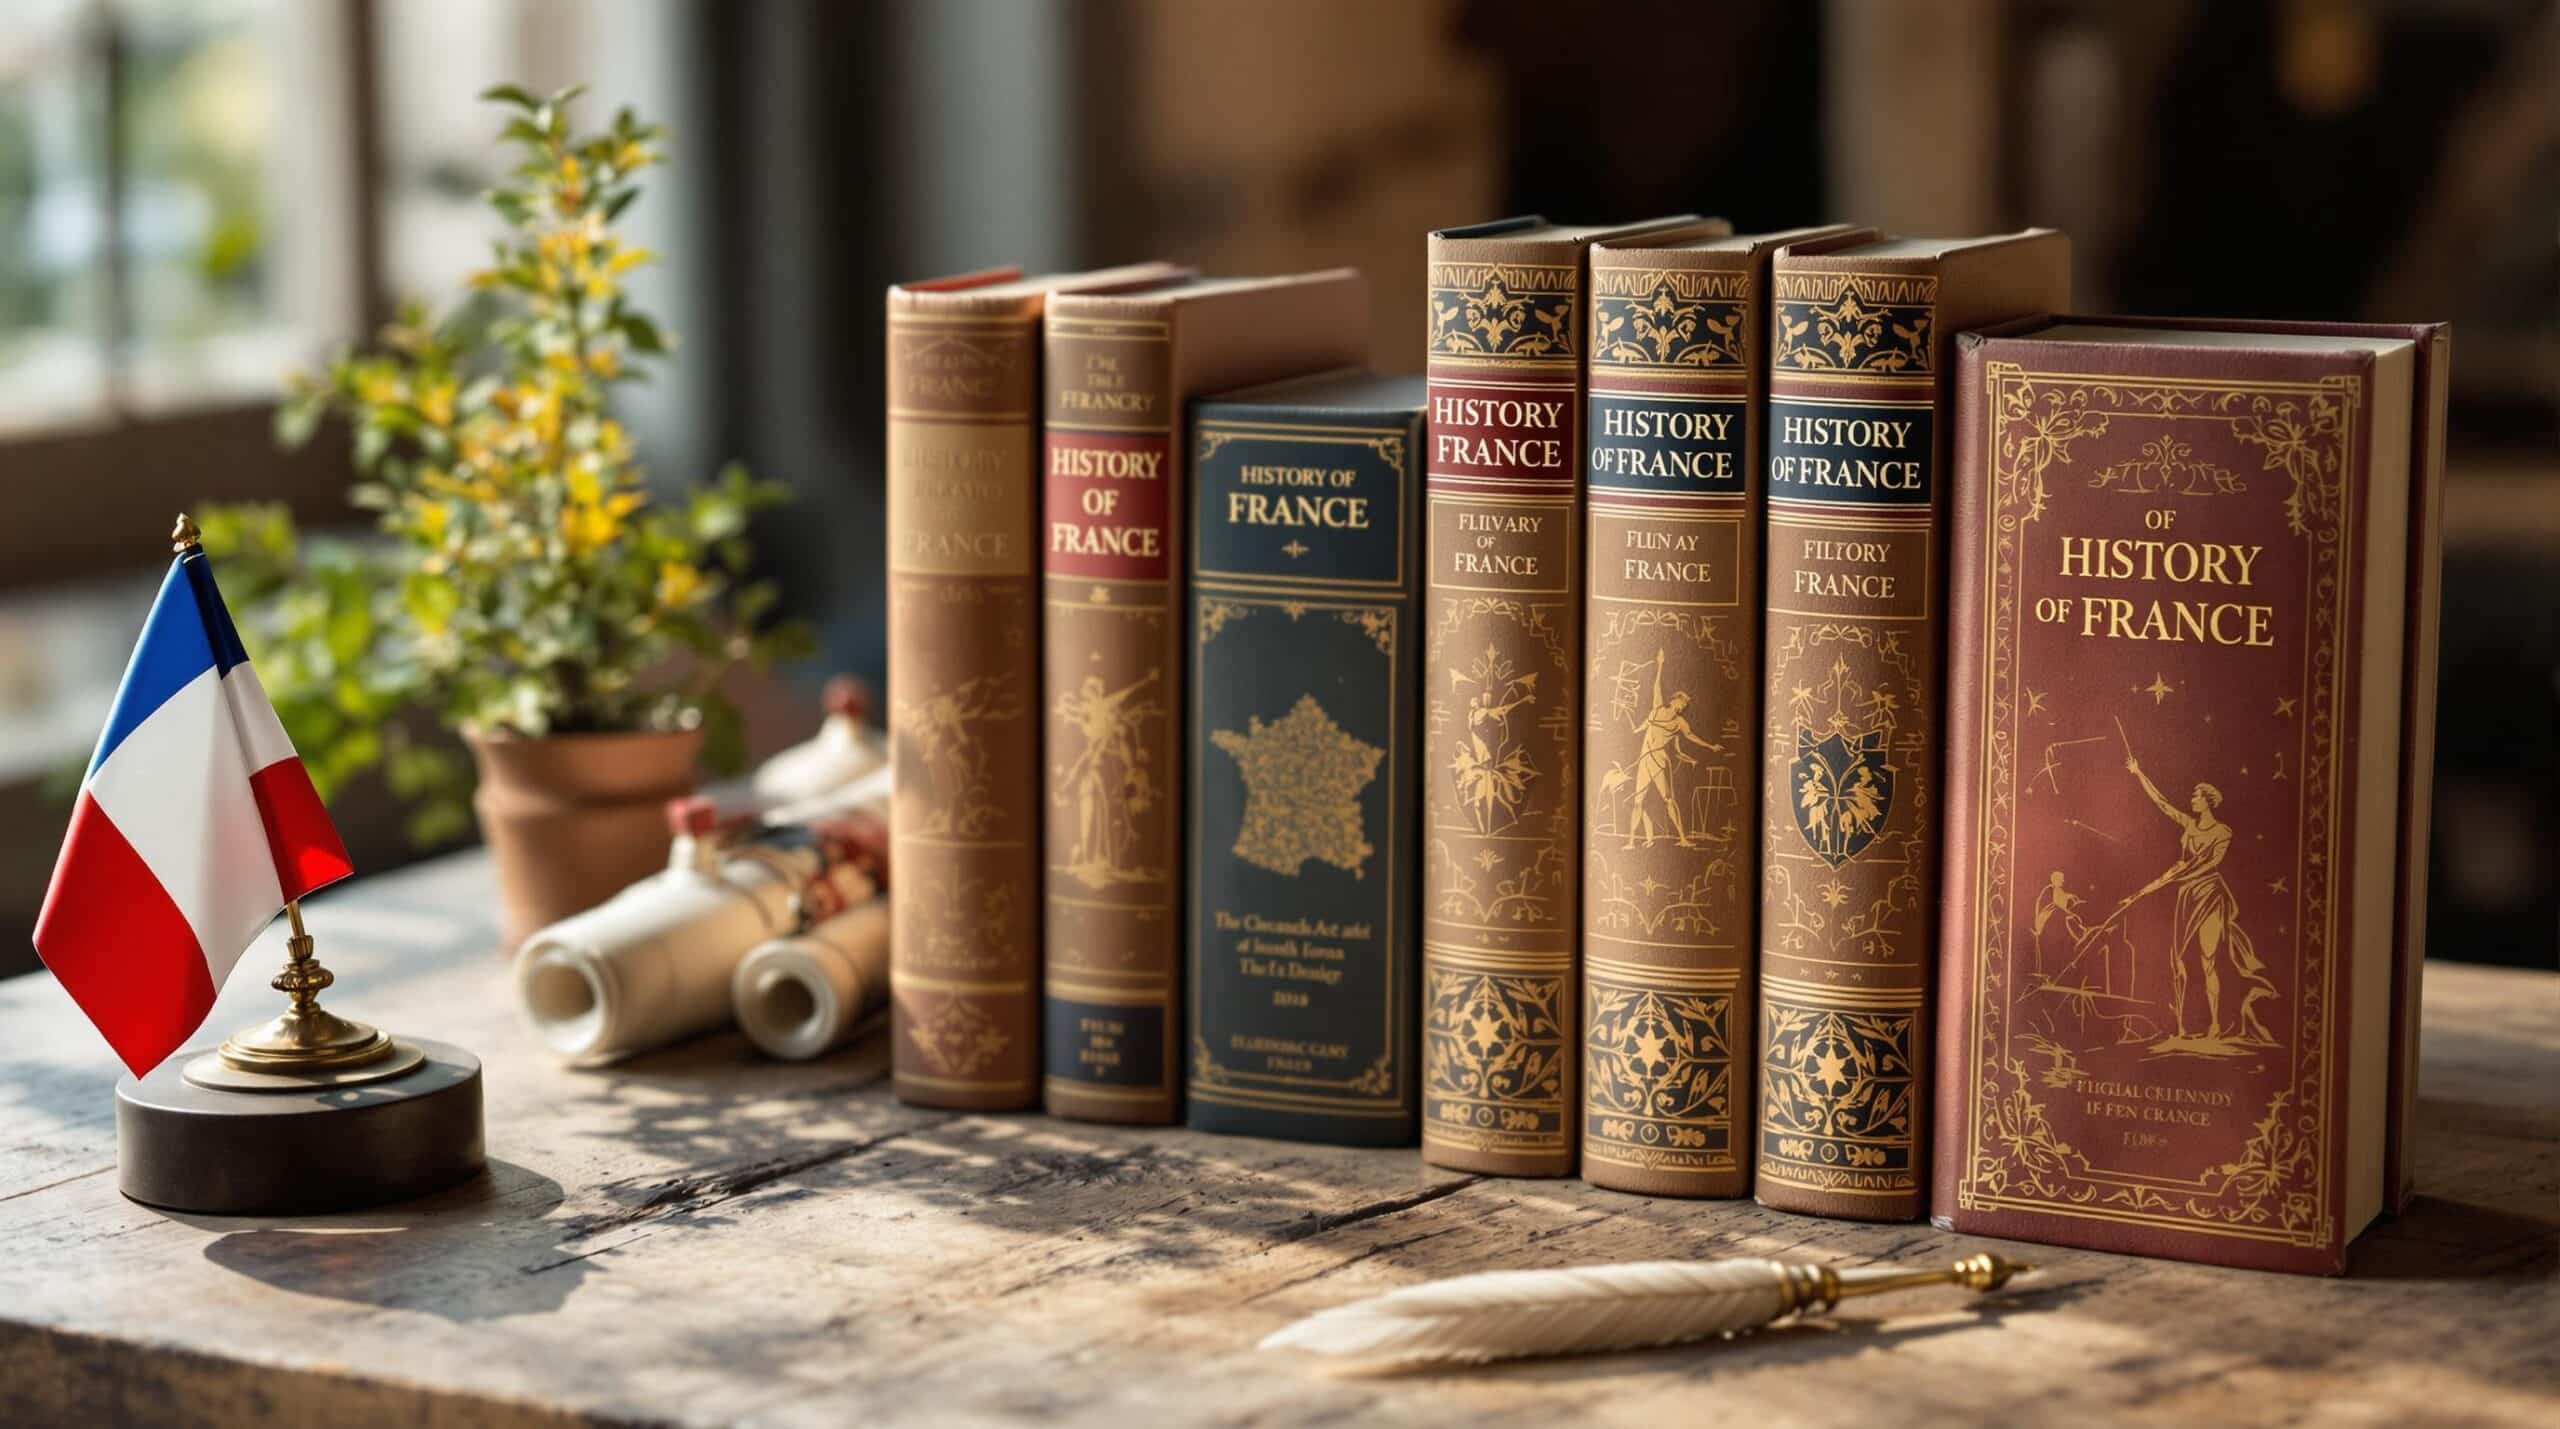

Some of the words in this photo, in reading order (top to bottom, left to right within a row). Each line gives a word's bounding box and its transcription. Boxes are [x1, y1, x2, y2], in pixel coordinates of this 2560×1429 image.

[1434, 396, 1564, 428] HISTORY
[1603, 408, 1734, 441] HISTORY
[1783, 416, 1913, 449] HISTORY
[1051, 447, 1163, 479] HISTORY
[1437, 433, 1562, 468] FRANCE
[1591, 447, 1614, 472] OF
[1615, 447, 1733, 479] FRANCE
[1240, 465, 1327, 487] HISTORY
[1330, 469, 1357, 488] OF
[1771, 455, 1796, 482] OF
[1798, 456, 1922, 490] FRANCE
[1082, 488, 1120, 516] OF
[1228, 491, 1370, 529] FRANCE
[2144, 509, 2177, 530] OF
[1052, 522, 1161, 558] FRANCE
[1476, 535, 1496, 549] OF
[1454, 551, 1539, 576] FRANCE
[1624, 558, 1712, 583] FRANCE
[2059, 536, 2264, 586] HISTORY
[1793, 569, 1896, 599] FRANCE
[2035, 597, 2073, 624] OF
[2080, 596, 2275, 647] FRANCE
